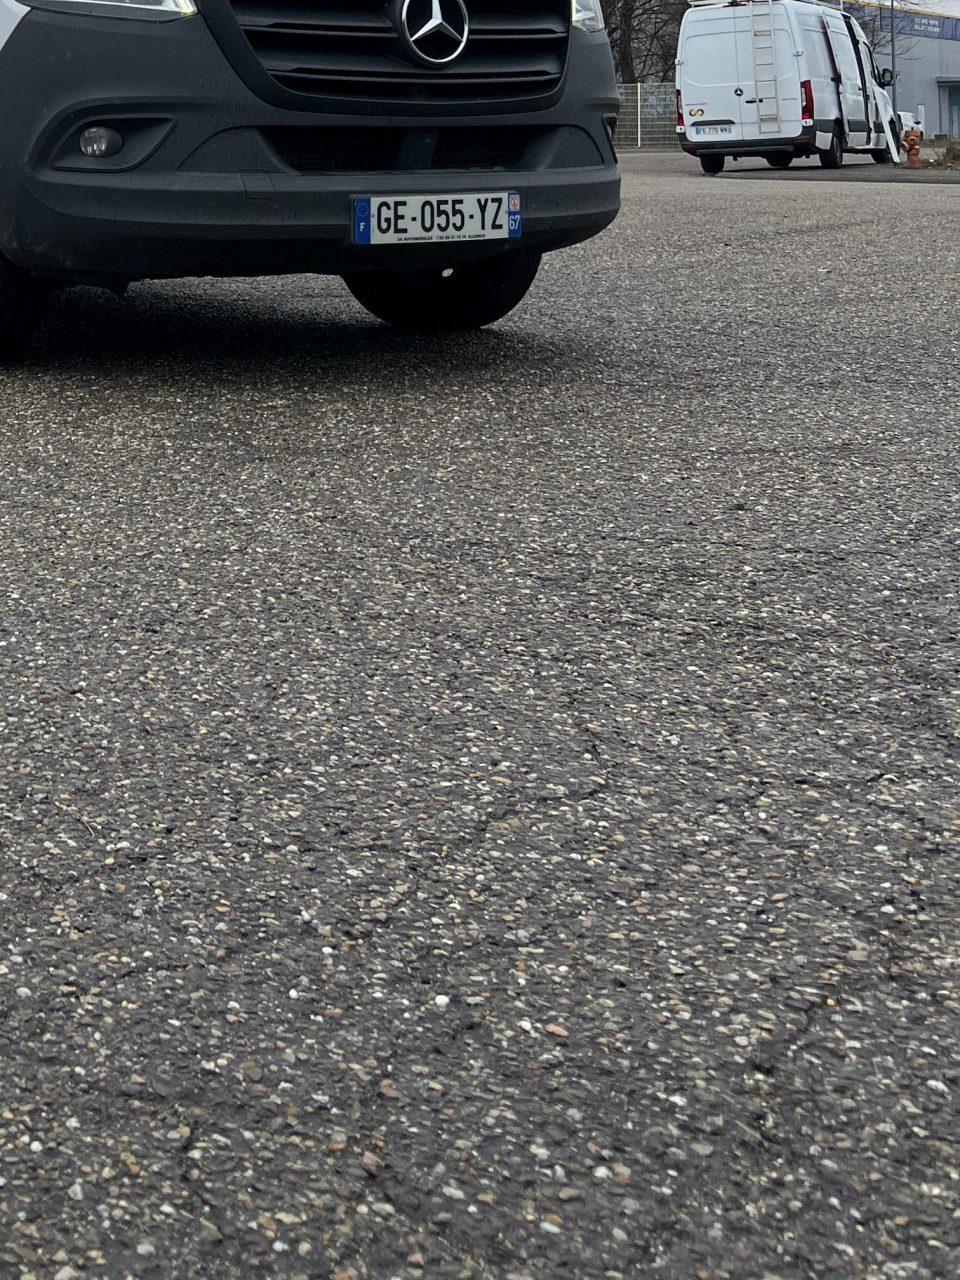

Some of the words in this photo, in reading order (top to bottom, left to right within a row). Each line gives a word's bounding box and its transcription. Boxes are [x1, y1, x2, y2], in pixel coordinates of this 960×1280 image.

[359, 222, 366, 232] F
[376, 197, 503, 234] GE-055-YZ
[509, 214, 521, 231] 67
